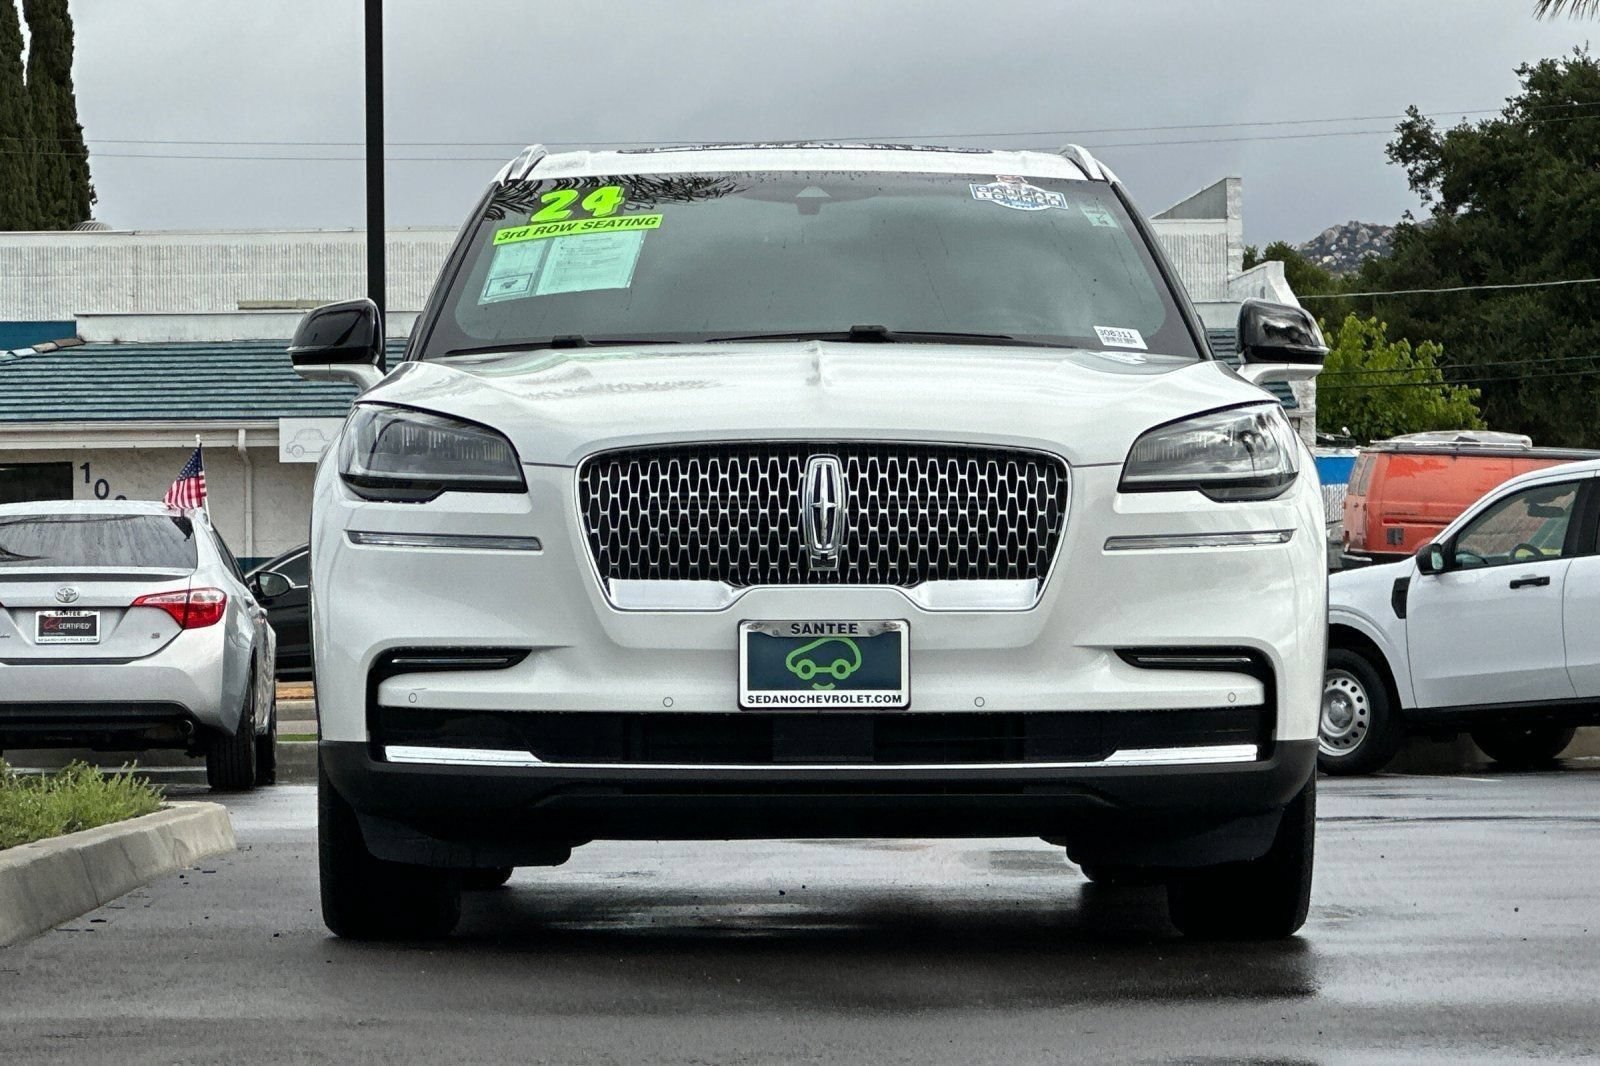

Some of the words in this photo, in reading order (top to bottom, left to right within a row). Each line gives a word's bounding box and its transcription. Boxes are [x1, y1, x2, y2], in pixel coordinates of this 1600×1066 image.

[531, 186, 625, 222] 24
[497, 228, 531, 242] 3rd
[533, 222, 579, 236] ROW
[580, 216, 658, 231] SEATING
[790, 623, 858, 635] SANTEE
[747, 694, 902, 704] SEDANOCHEVROLET.COM
